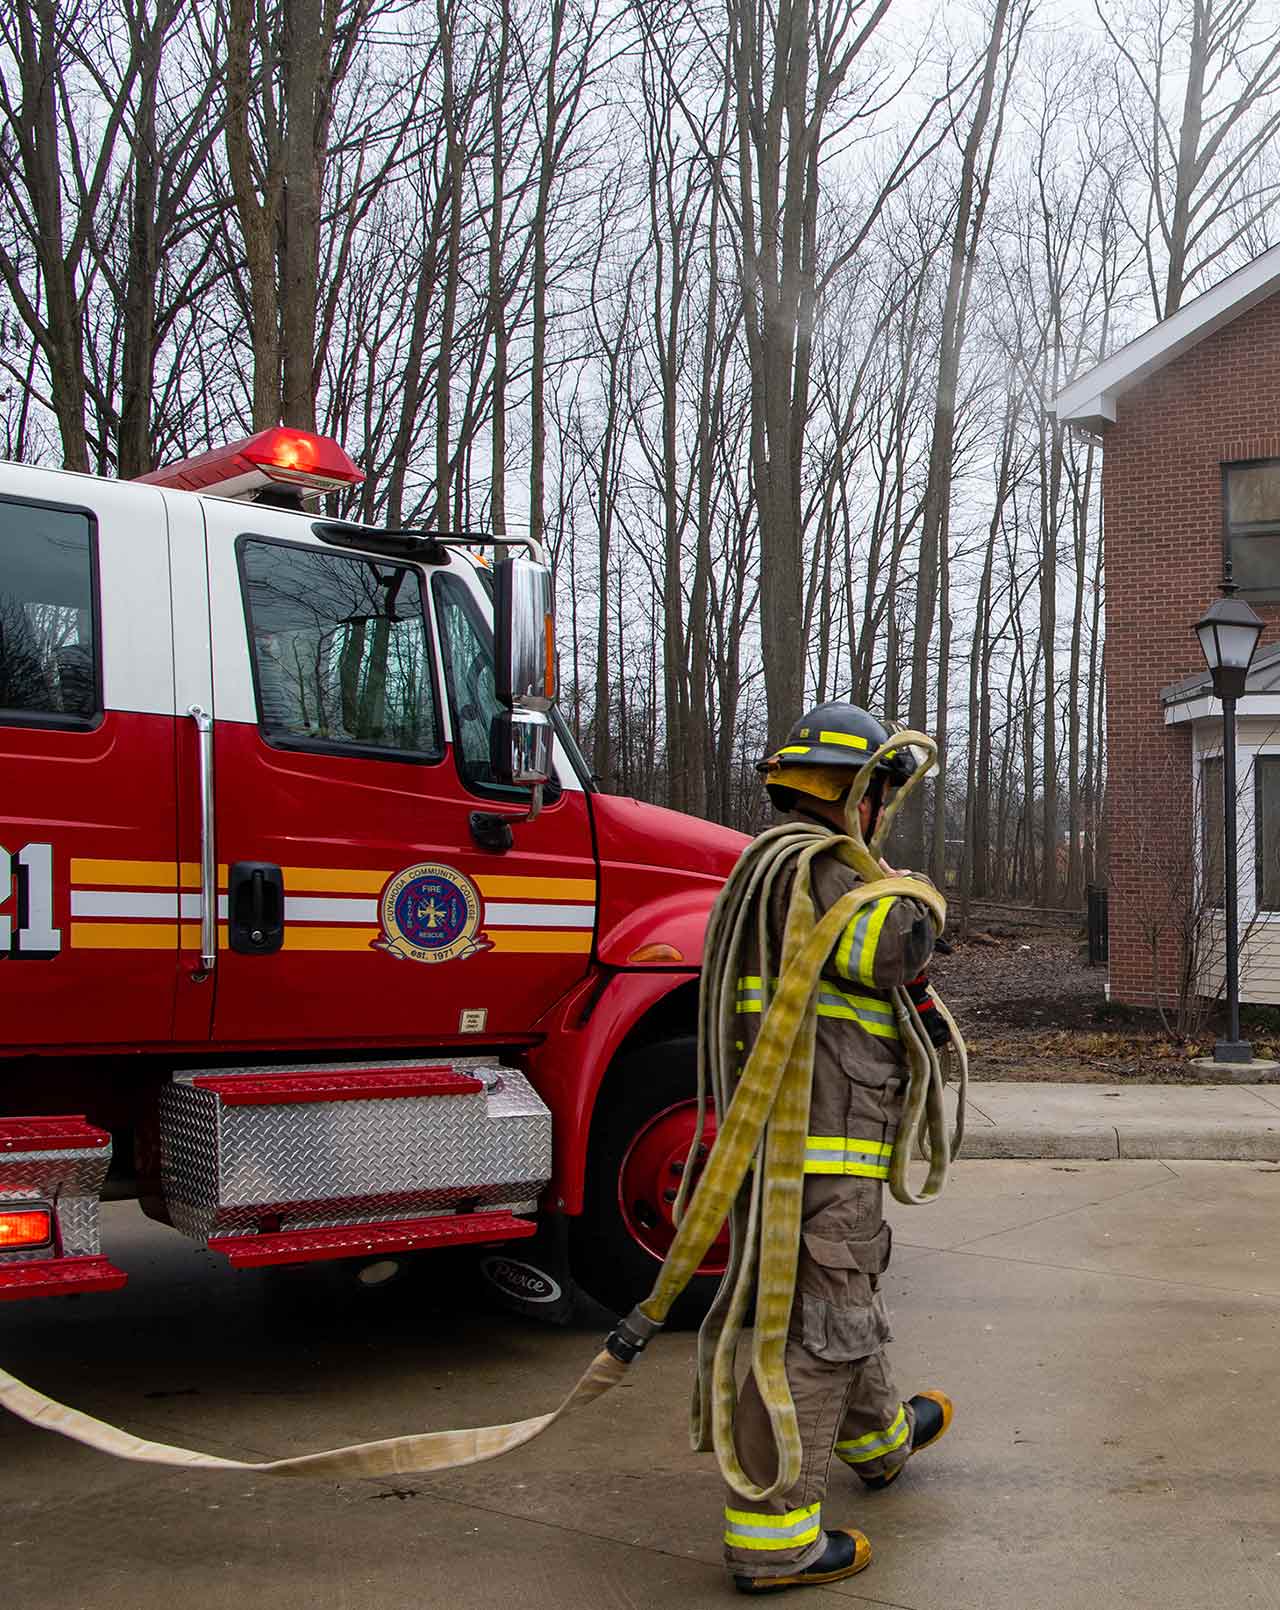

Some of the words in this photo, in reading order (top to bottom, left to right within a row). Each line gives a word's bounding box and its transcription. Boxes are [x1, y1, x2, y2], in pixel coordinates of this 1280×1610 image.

[0, 843, 62, 954] 1
[386, 880, 407, 921] CUYAHOGA
[409, 867, 458, 881] COMMUNITY
[460, 882, 475, 920] COLLEGE
[422, 884, 441, 894] FIRE
[410, 949, 428, 960] est.
[432, 948, 454, 960] 1971
